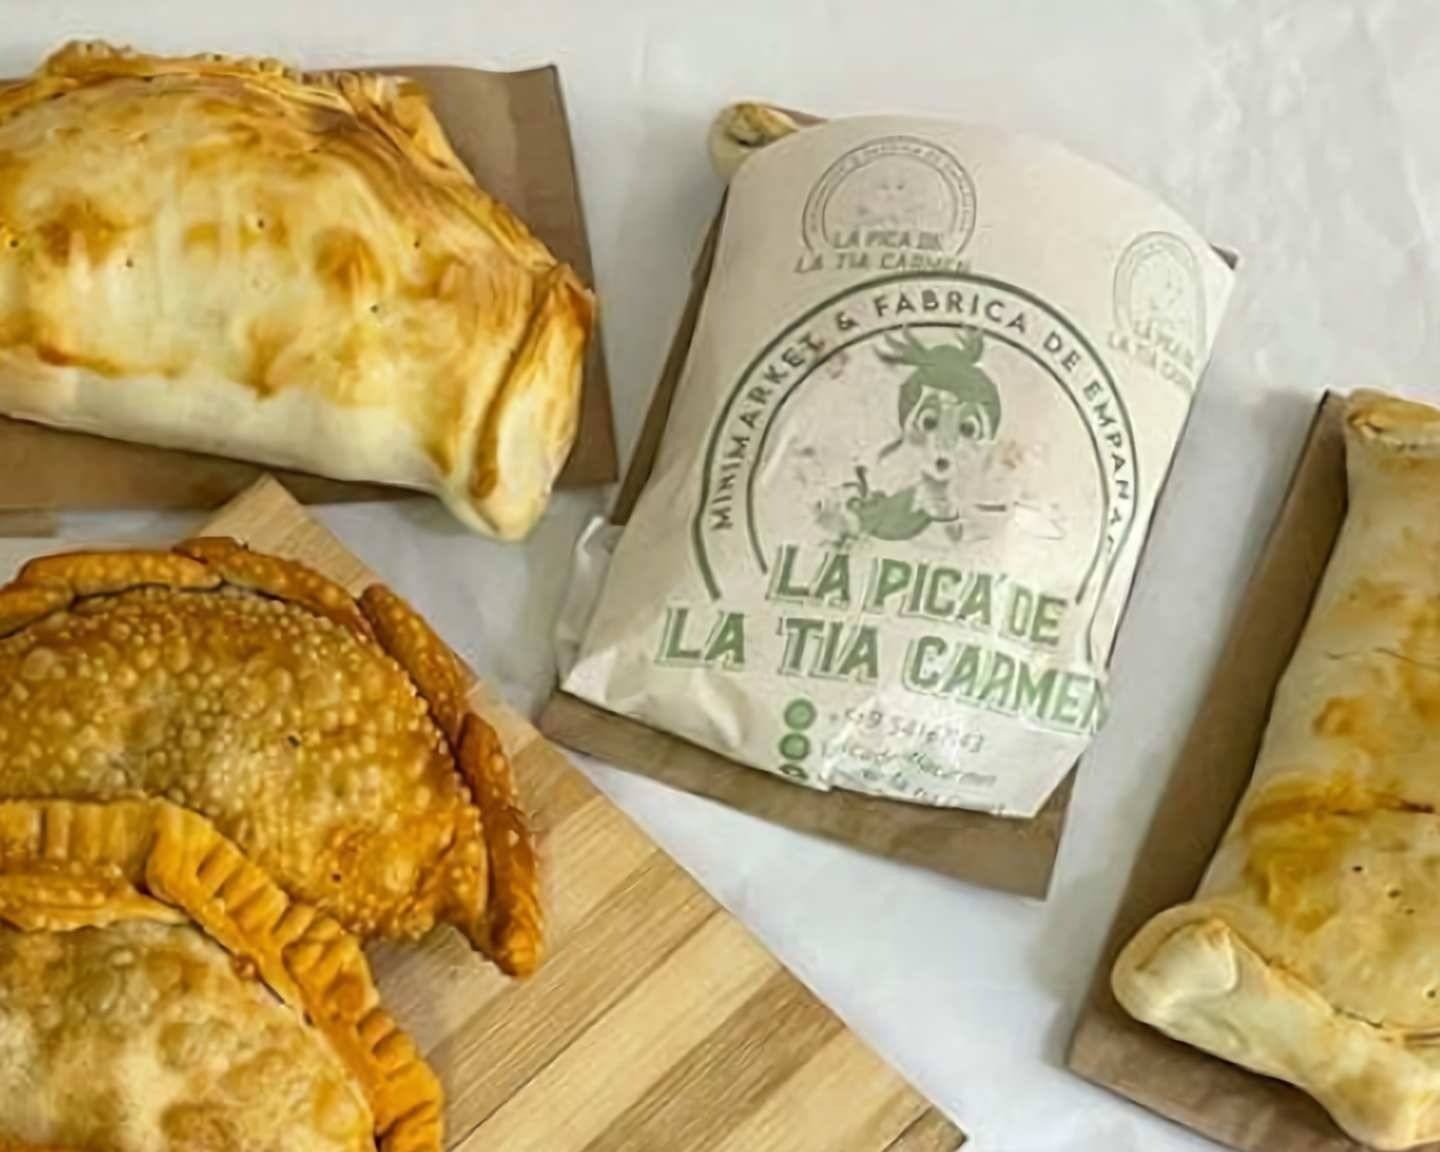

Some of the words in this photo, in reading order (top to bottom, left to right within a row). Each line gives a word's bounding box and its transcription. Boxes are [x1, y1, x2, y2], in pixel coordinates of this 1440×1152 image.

[710, 333, 826, 532] MINIMARKET
[834, 311, 859, 332] &
[874, 289, 1027, 334] FABRICA
[1043, 330, 1080, 372] DE
[656, 606, 746, 672] LA
[777, 616, 880, 683] TIA
[768, 543, 852, 606] LA
[1000, 584, 1068, 647] DE
